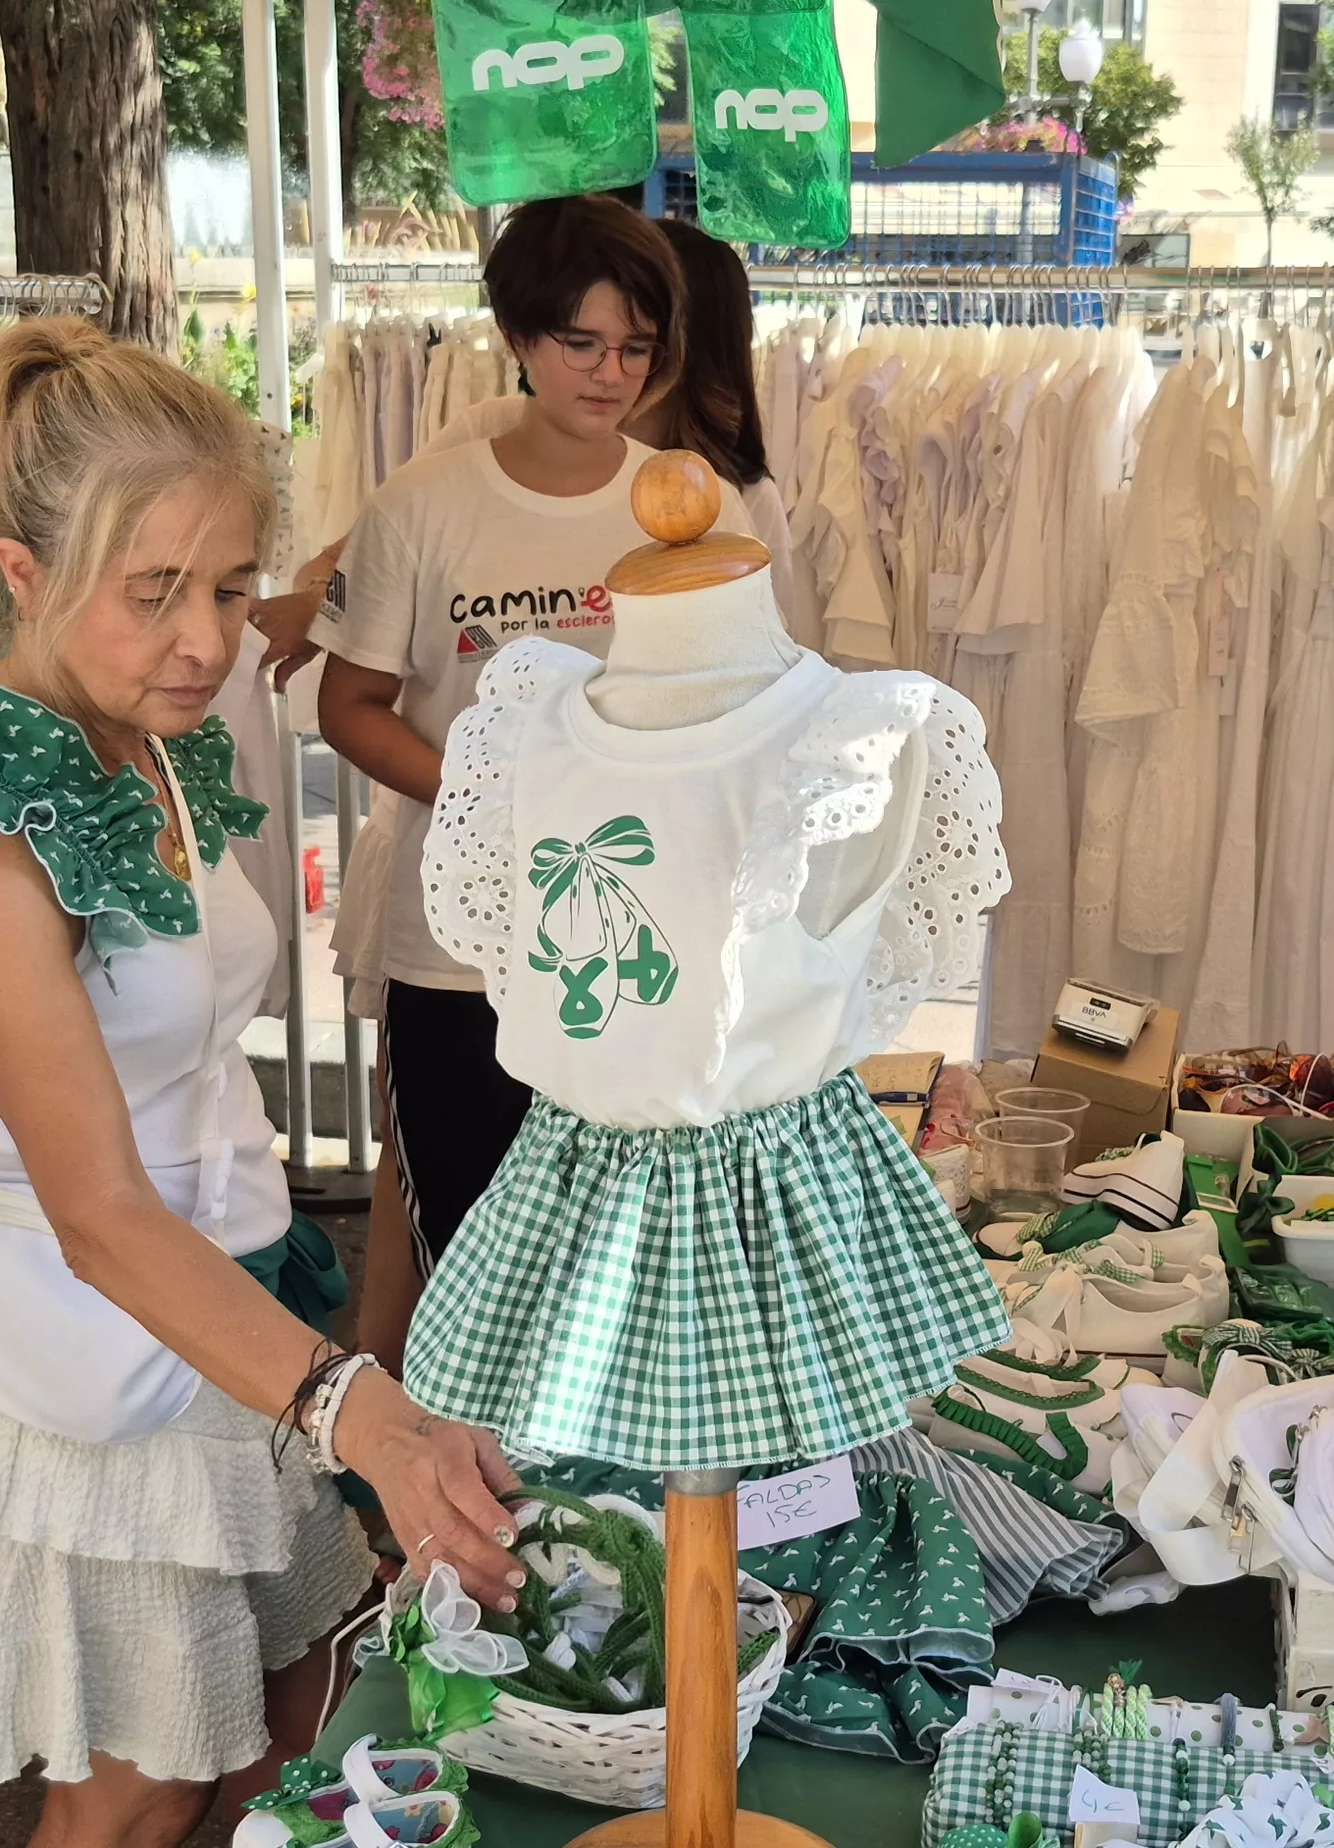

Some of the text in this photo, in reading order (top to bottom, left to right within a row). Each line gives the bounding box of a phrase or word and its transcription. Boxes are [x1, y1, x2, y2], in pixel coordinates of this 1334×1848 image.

[471, 34, 625, 91] nop
[714, 88, 829, 143] nop
[500, 614, 616, 634] por la esclero
[1081, 1005, 1107, 1019] BBVA
[766, 1500, 817, 1528] 15€
